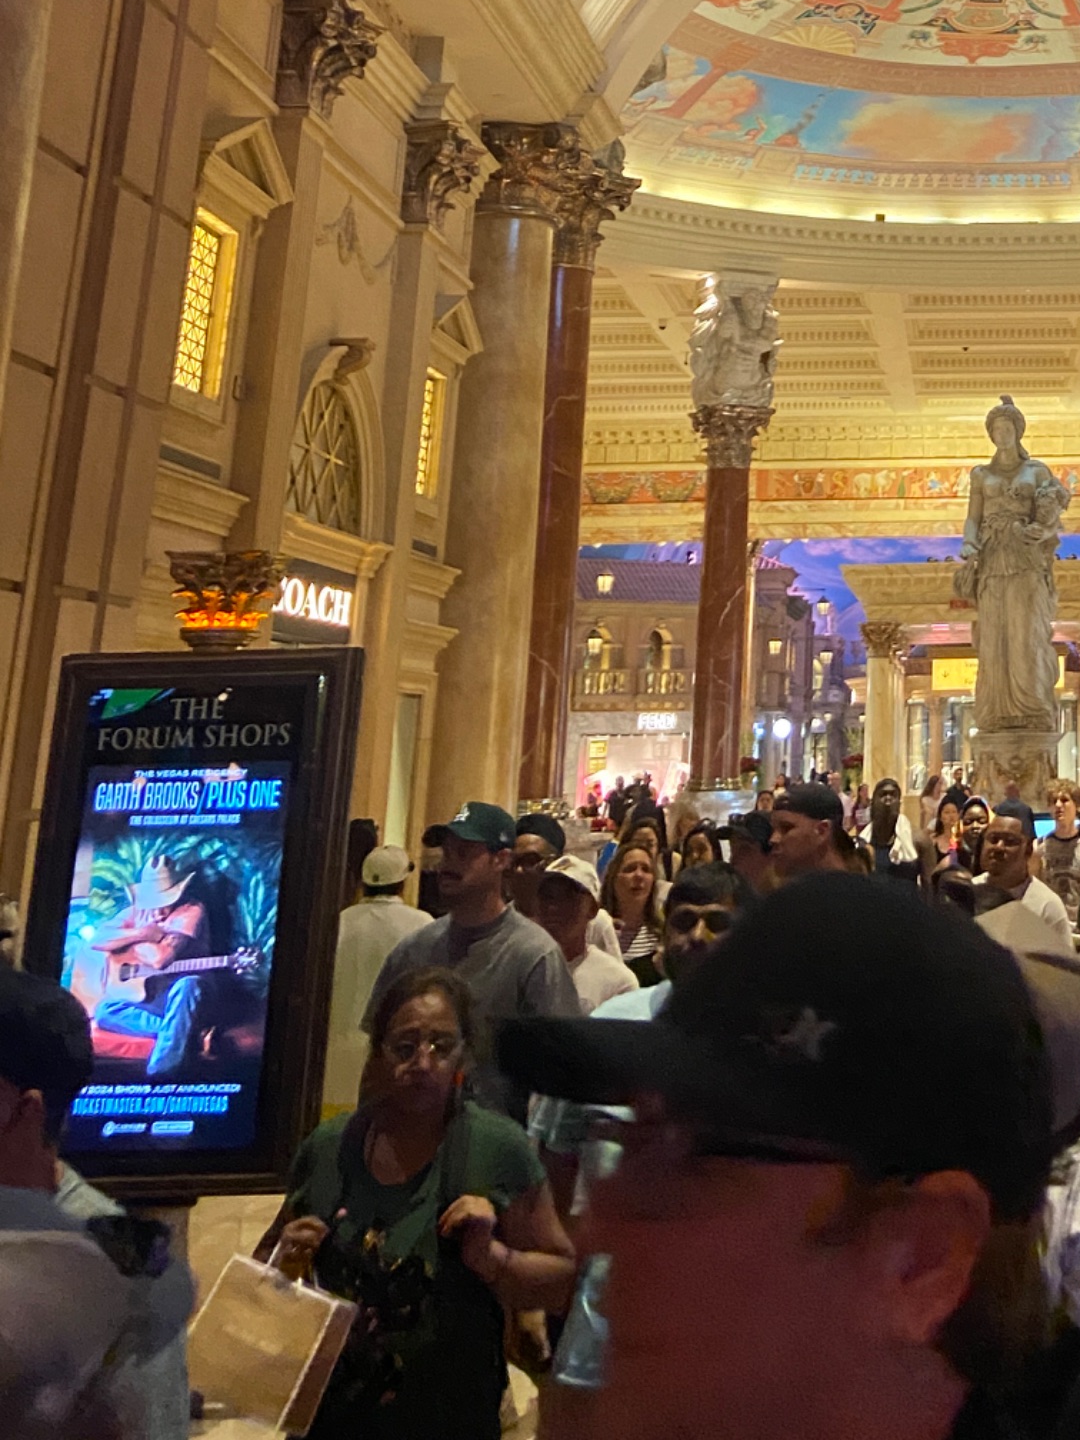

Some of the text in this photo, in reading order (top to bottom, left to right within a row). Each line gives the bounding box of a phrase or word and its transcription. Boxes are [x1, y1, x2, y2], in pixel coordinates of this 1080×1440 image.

[170, 697, 225, 720] THE
[97, 722, 292, 751] FORUM SHOPS
[134, 769, 155, 778] THE
[156, 768, 190, 778] VEGAS
[95, 782, 141, 811] GARTH
[249, 779, 282, 808] ONE
